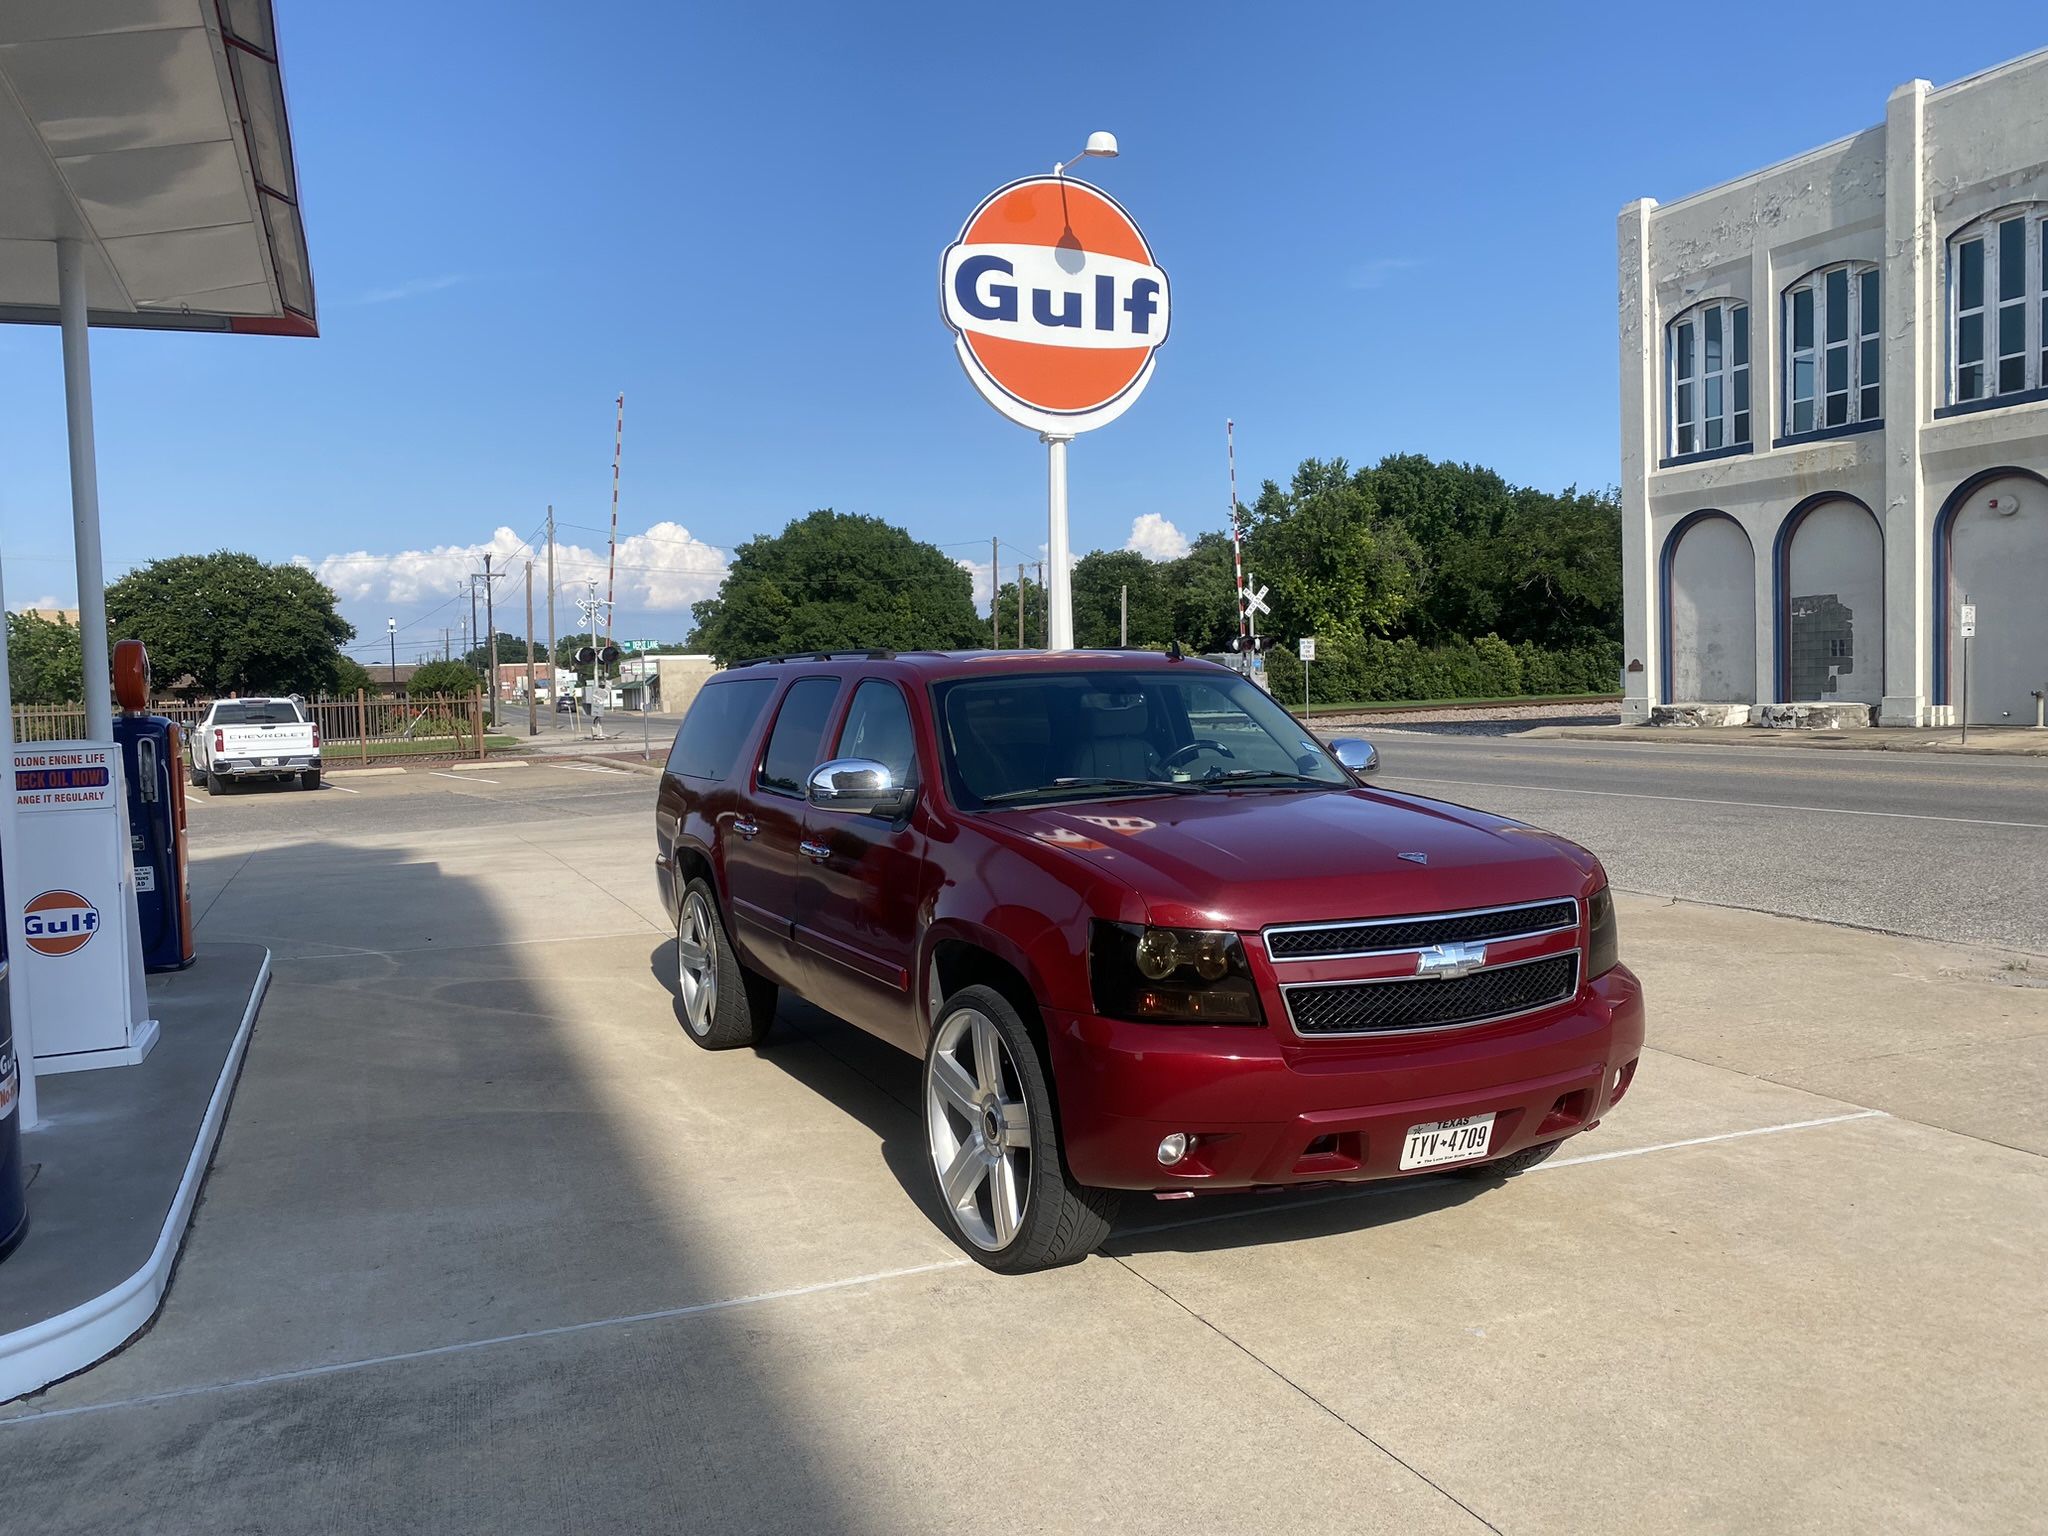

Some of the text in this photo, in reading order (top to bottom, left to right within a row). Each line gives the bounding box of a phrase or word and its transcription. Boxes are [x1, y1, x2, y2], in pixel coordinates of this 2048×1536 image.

[955, 254, 1160, 335] Gulf
[647, 640, 659, 649] LANE
[49, 754, 82, 766] ENGINE
[86, 753, 105, 764] LIFE
[49, 771, 68, 787] OIL
[72, 769, 105, 786] NOW!
[44, 794, 52, 803] IT
[55, 791, 105, 803] REGULARLY
[24, 912, 96, 935] Gulf
[1437, 1118, 1470, 1130] TEXAS
